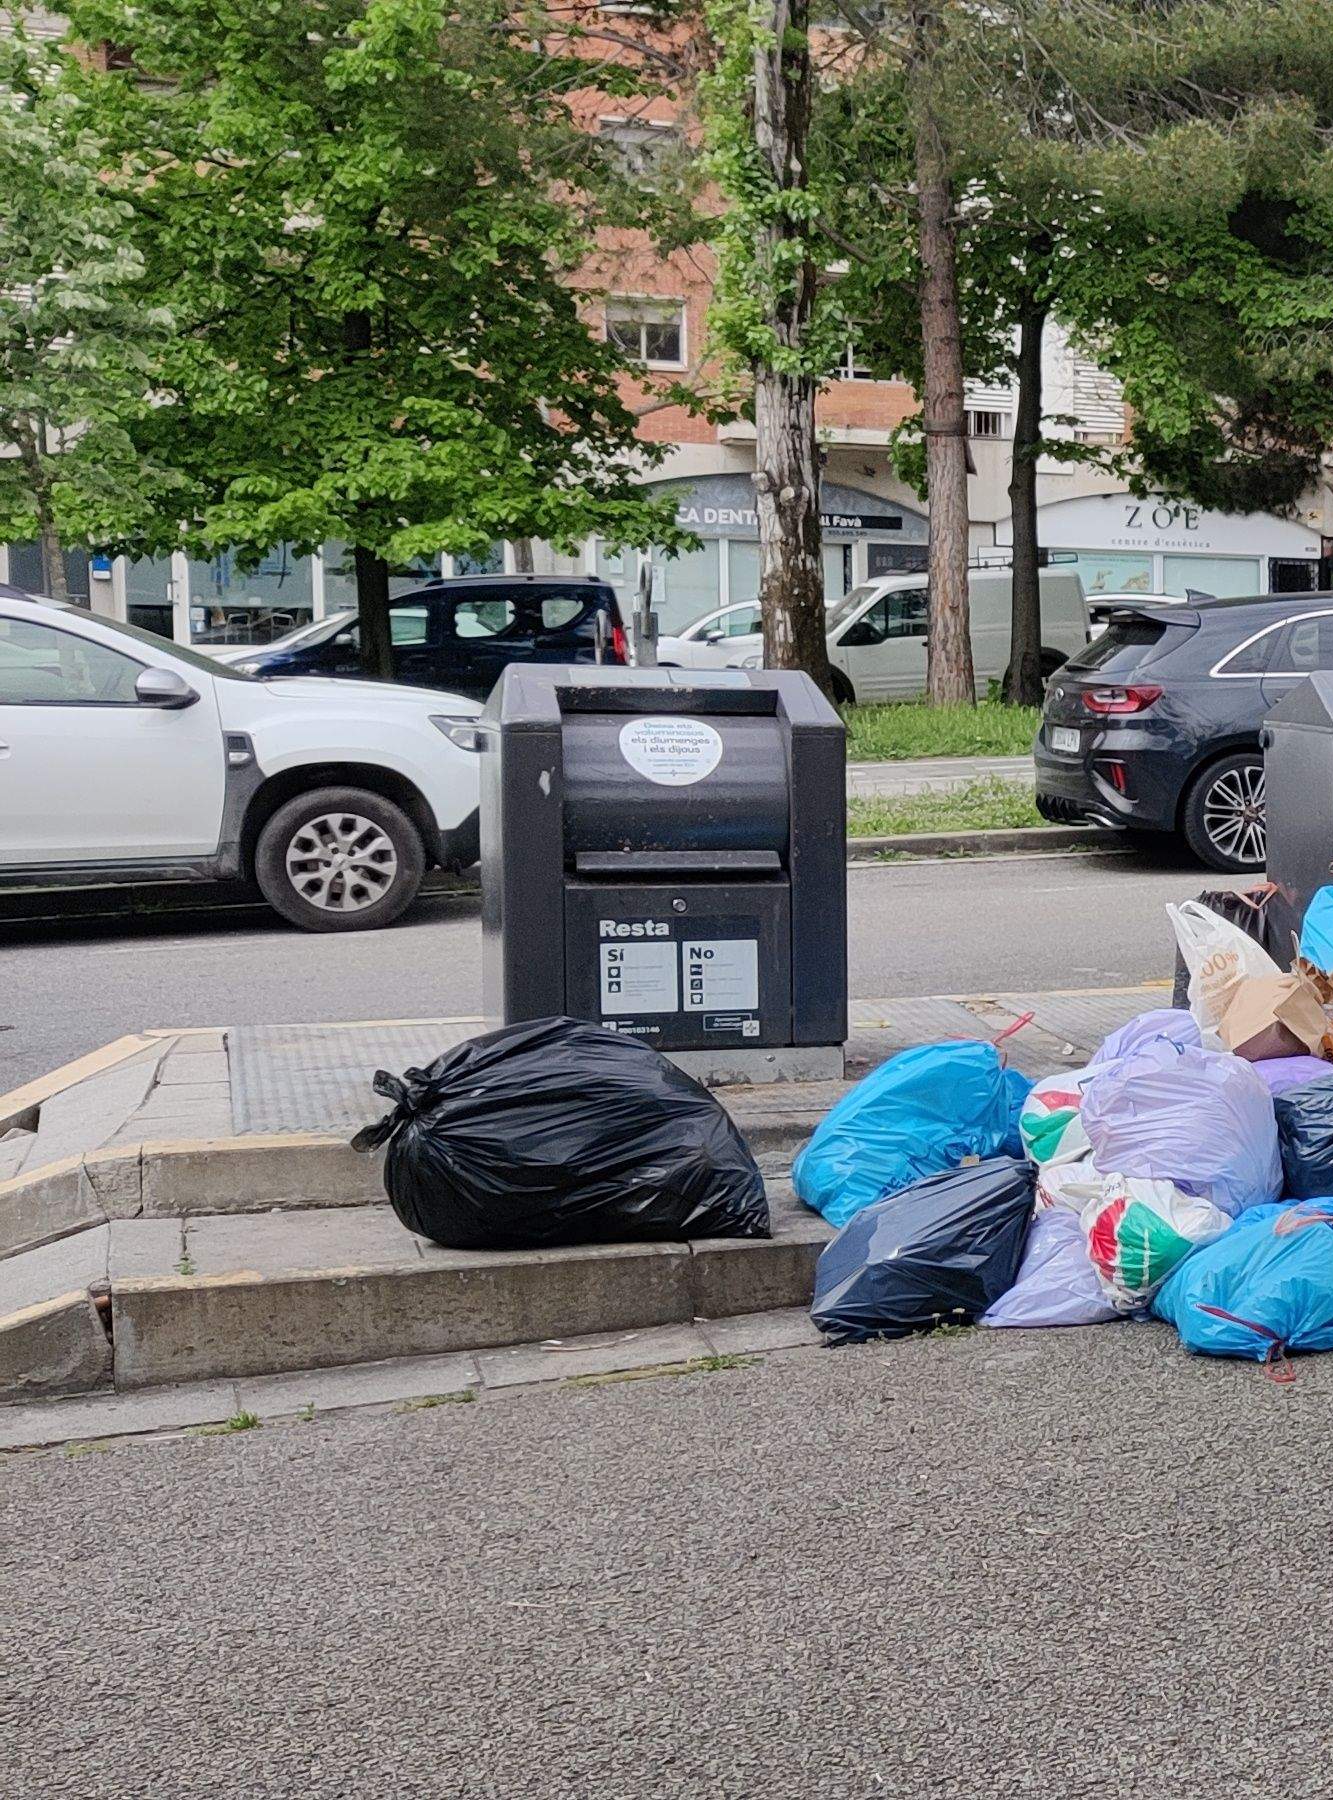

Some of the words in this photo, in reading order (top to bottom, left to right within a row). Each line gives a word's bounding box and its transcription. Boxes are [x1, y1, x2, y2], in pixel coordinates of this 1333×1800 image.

[631, 736, 647, 744] els
[650, 736, 710, 746] diumenges
[649, 745, 665, 753] els
[668, 745, 701, 755] dijous
[599, 919, 670, 937] Resta
[607, 948, 625, 962] Sí
[689, 947, 715, 960] No
